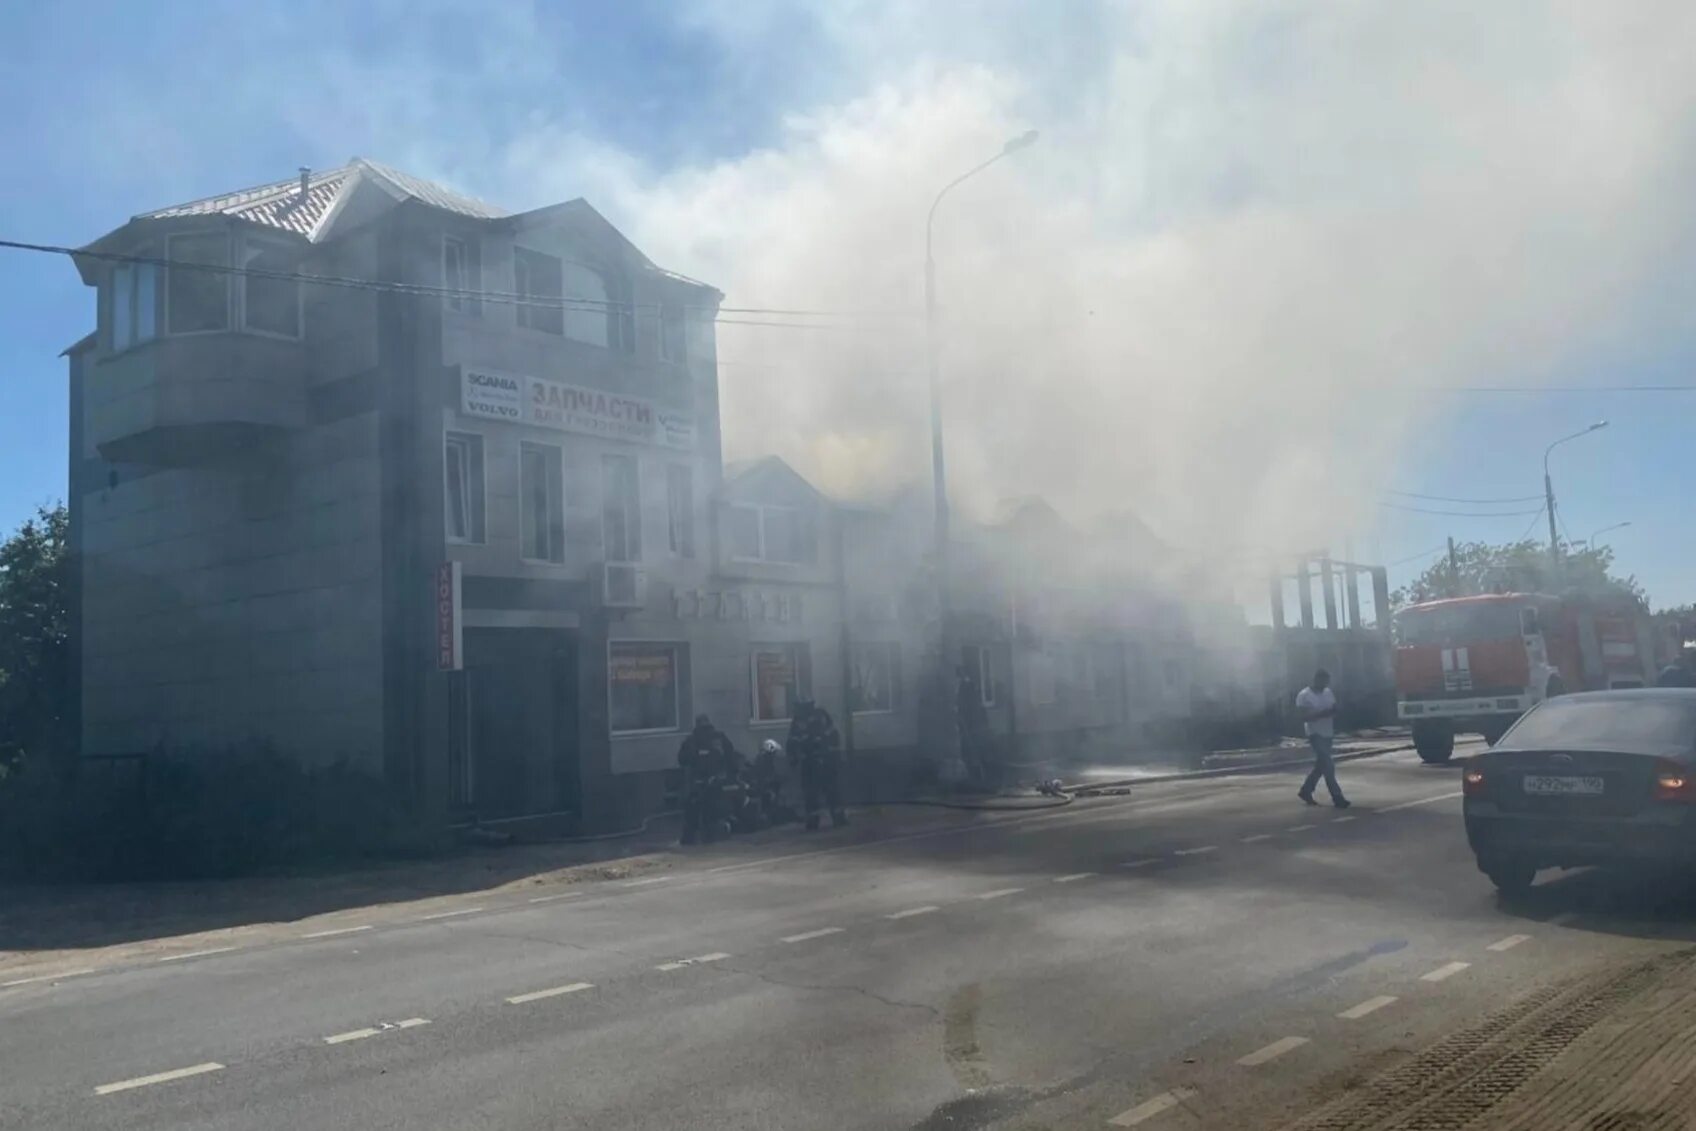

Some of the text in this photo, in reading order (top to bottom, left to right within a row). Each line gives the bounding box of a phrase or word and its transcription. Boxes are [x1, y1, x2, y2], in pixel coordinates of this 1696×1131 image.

[468, 373, 518, 391] SCANIA
[468, 400, 519, 418] VOLVO
[532, 382, 651, 424] ЗАПЧАСТИ
